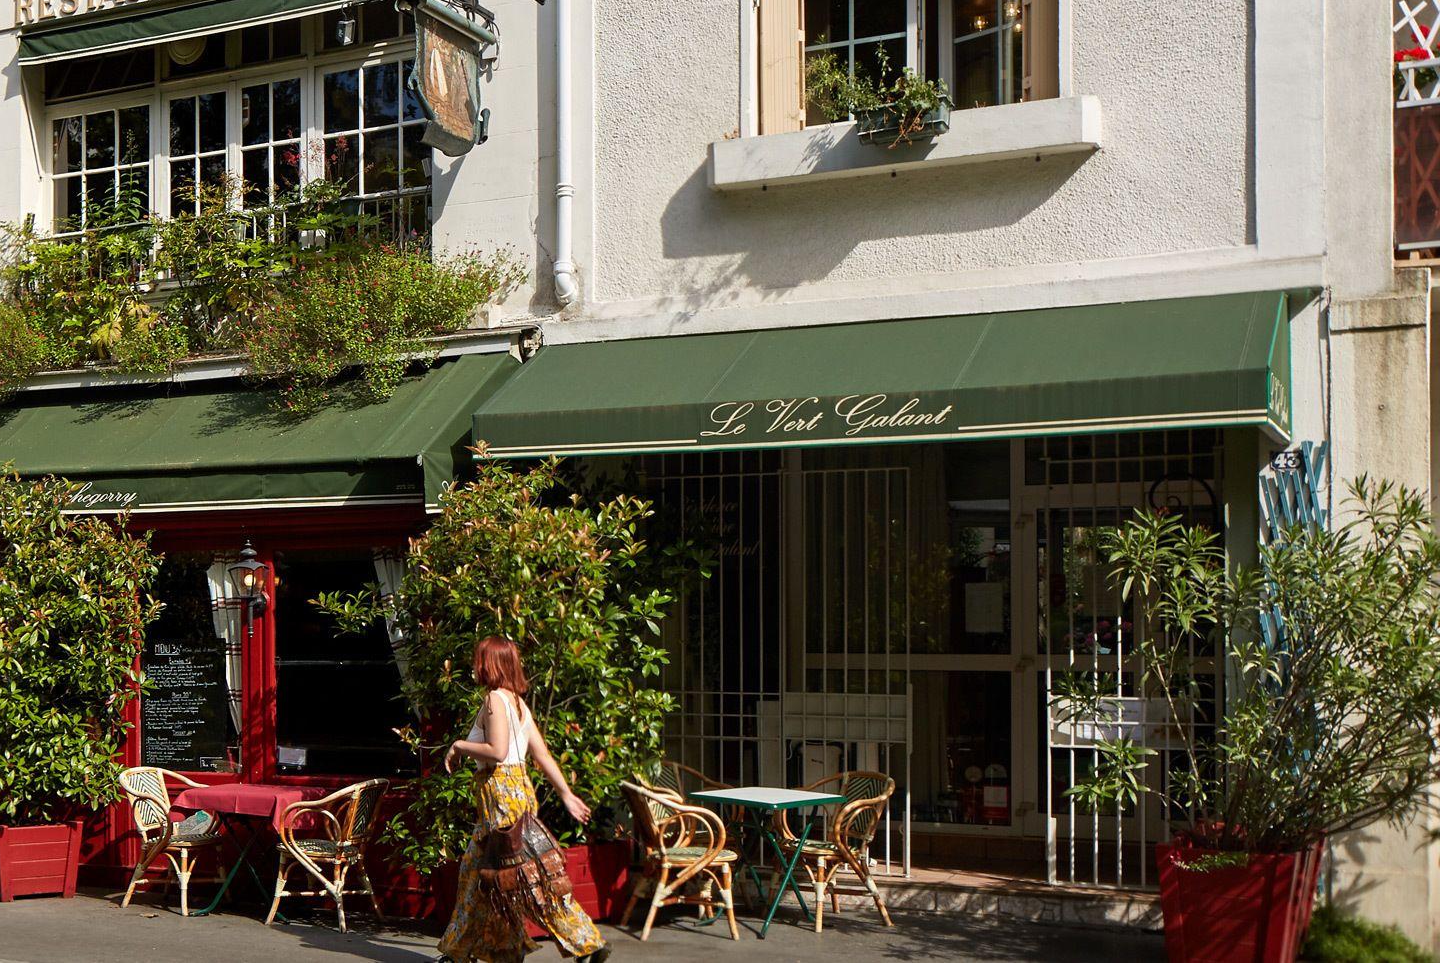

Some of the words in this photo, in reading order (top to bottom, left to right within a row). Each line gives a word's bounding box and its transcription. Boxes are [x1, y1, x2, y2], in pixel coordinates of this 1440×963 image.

[699, 401, 755, 436] Le
[766, 397, 824, 433] Vert
[835, 394, 953, 436] Galant
[1274, 451, 1301, 470] 43
